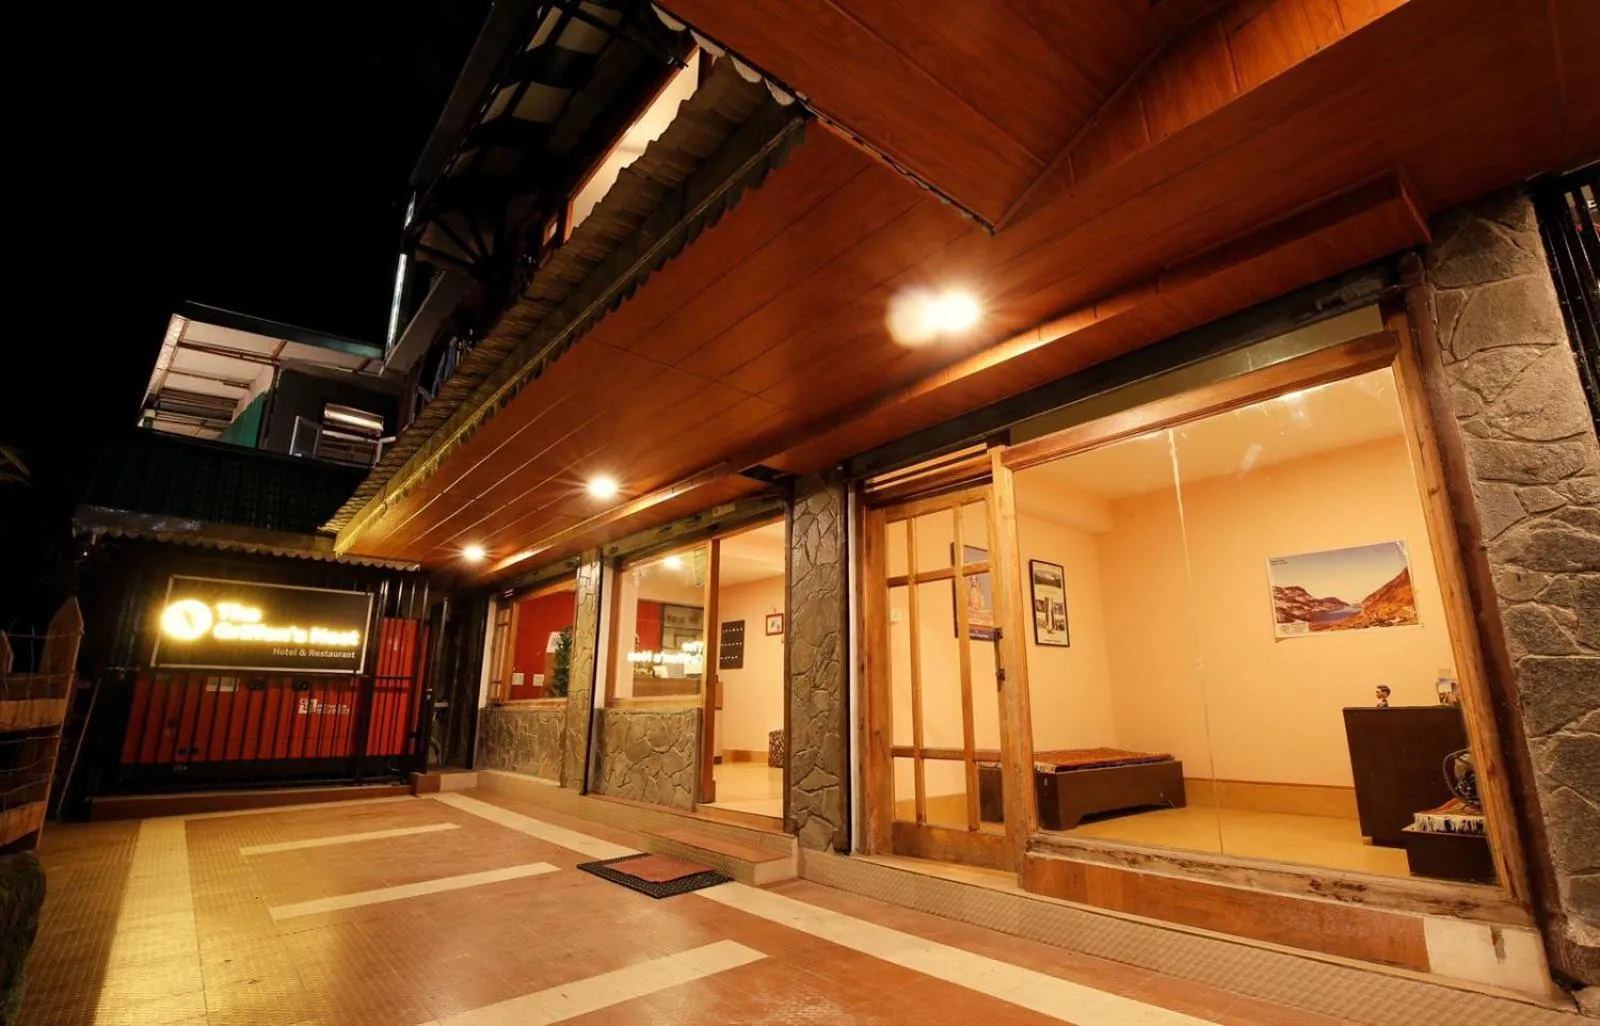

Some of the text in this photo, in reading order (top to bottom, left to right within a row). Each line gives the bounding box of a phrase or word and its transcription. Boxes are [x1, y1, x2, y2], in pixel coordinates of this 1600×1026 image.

[216, 603, 261, 622] The
[273, 647, 356, 659] Hotel & Restaurant
